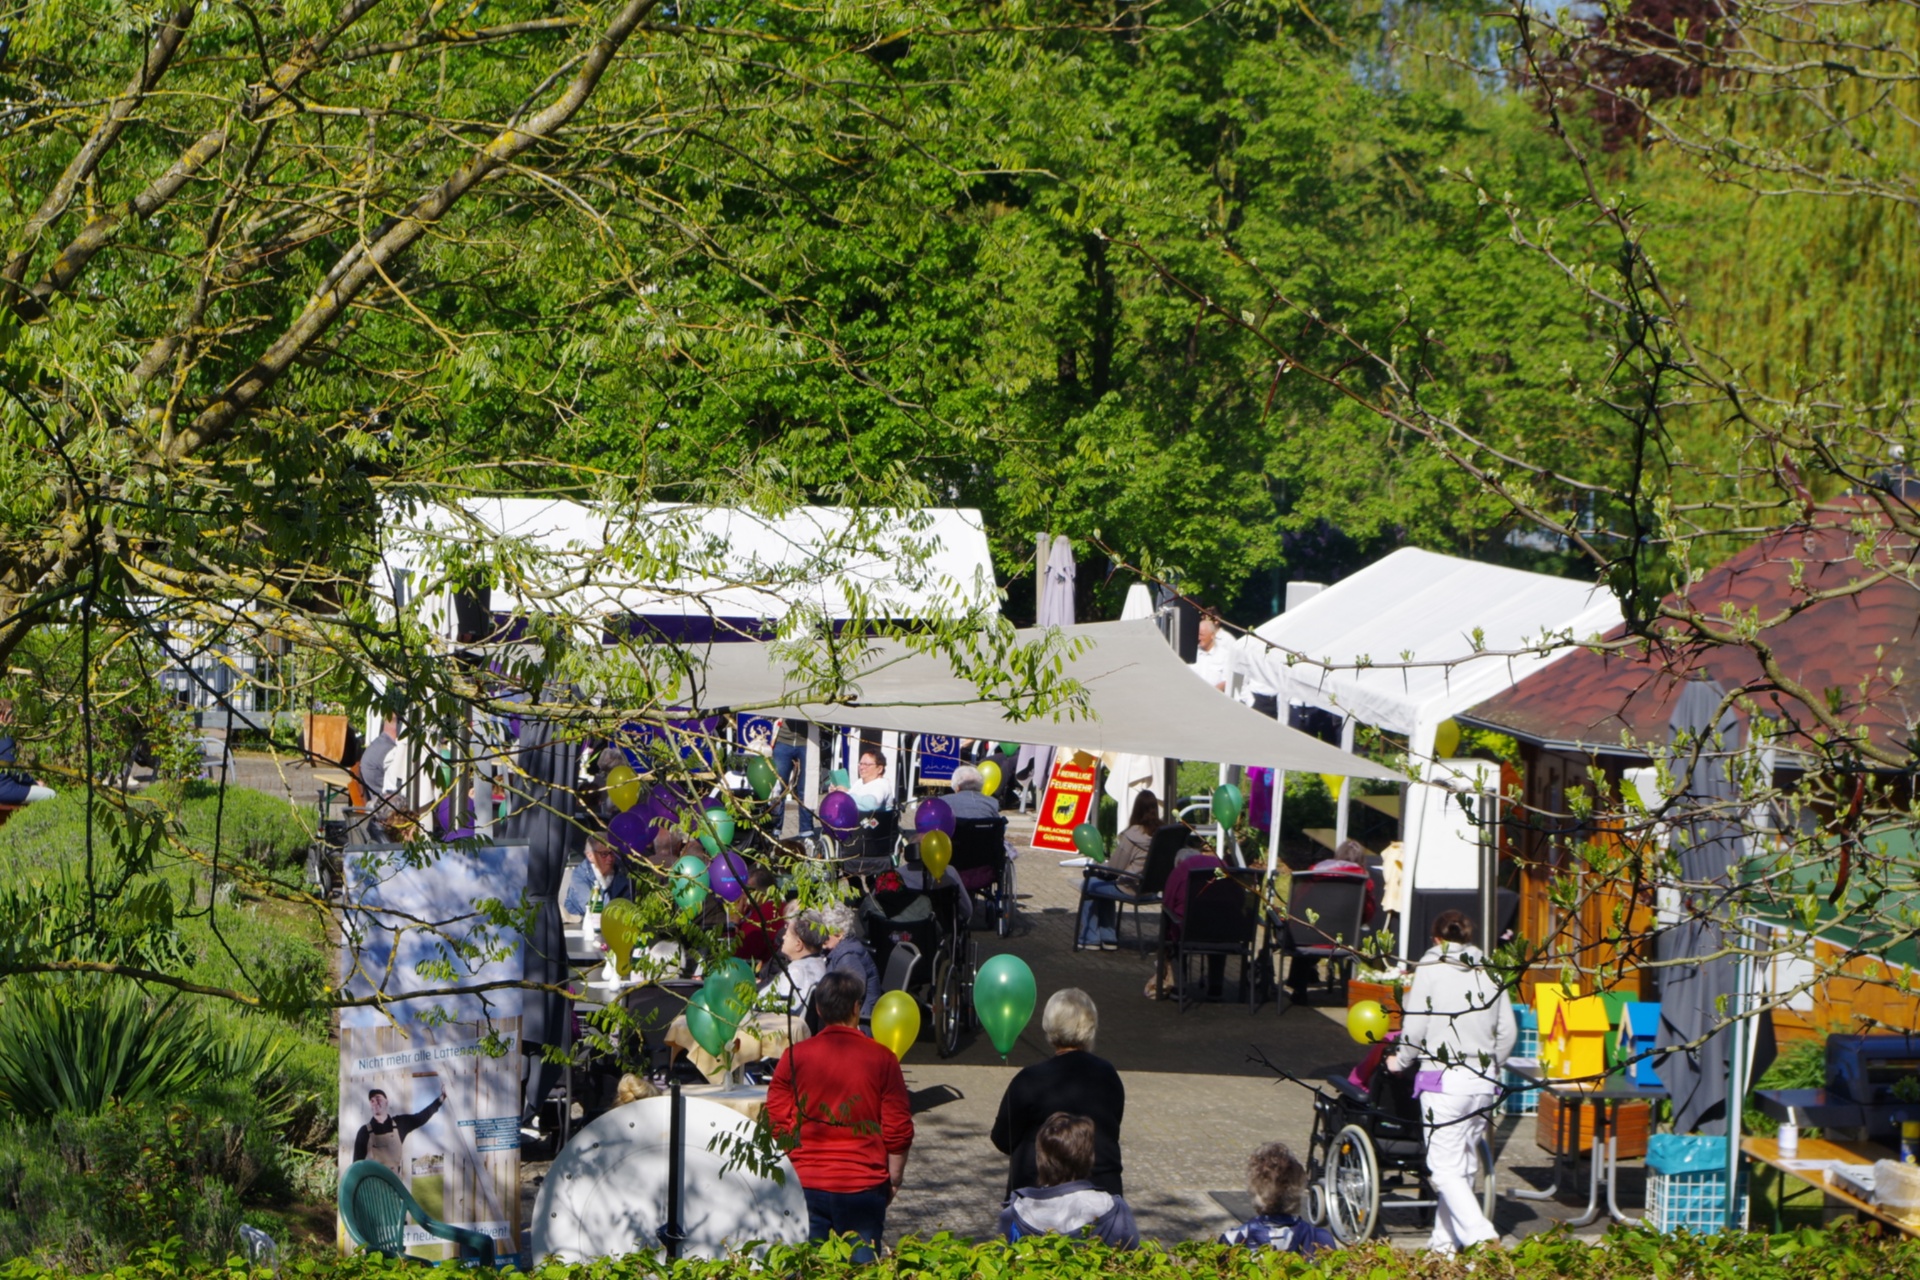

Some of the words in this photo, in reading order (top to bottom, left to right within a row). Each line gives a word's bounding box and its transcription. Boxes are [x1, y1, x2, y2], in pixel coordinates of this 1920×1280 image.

[1056, 769, 1093, 781] FREIWILLIGE
[1050, 778, 1093, 793] FEUERWEHR
[1042, 833, 1070, 843] GÜSTROW
[358, 1057, 383, 1070] Nicht
[386, 1052, 411, 1065] mehr
[415, 1050, 431, 1062] alle
[434, 1046, 466, 1060] Latten
